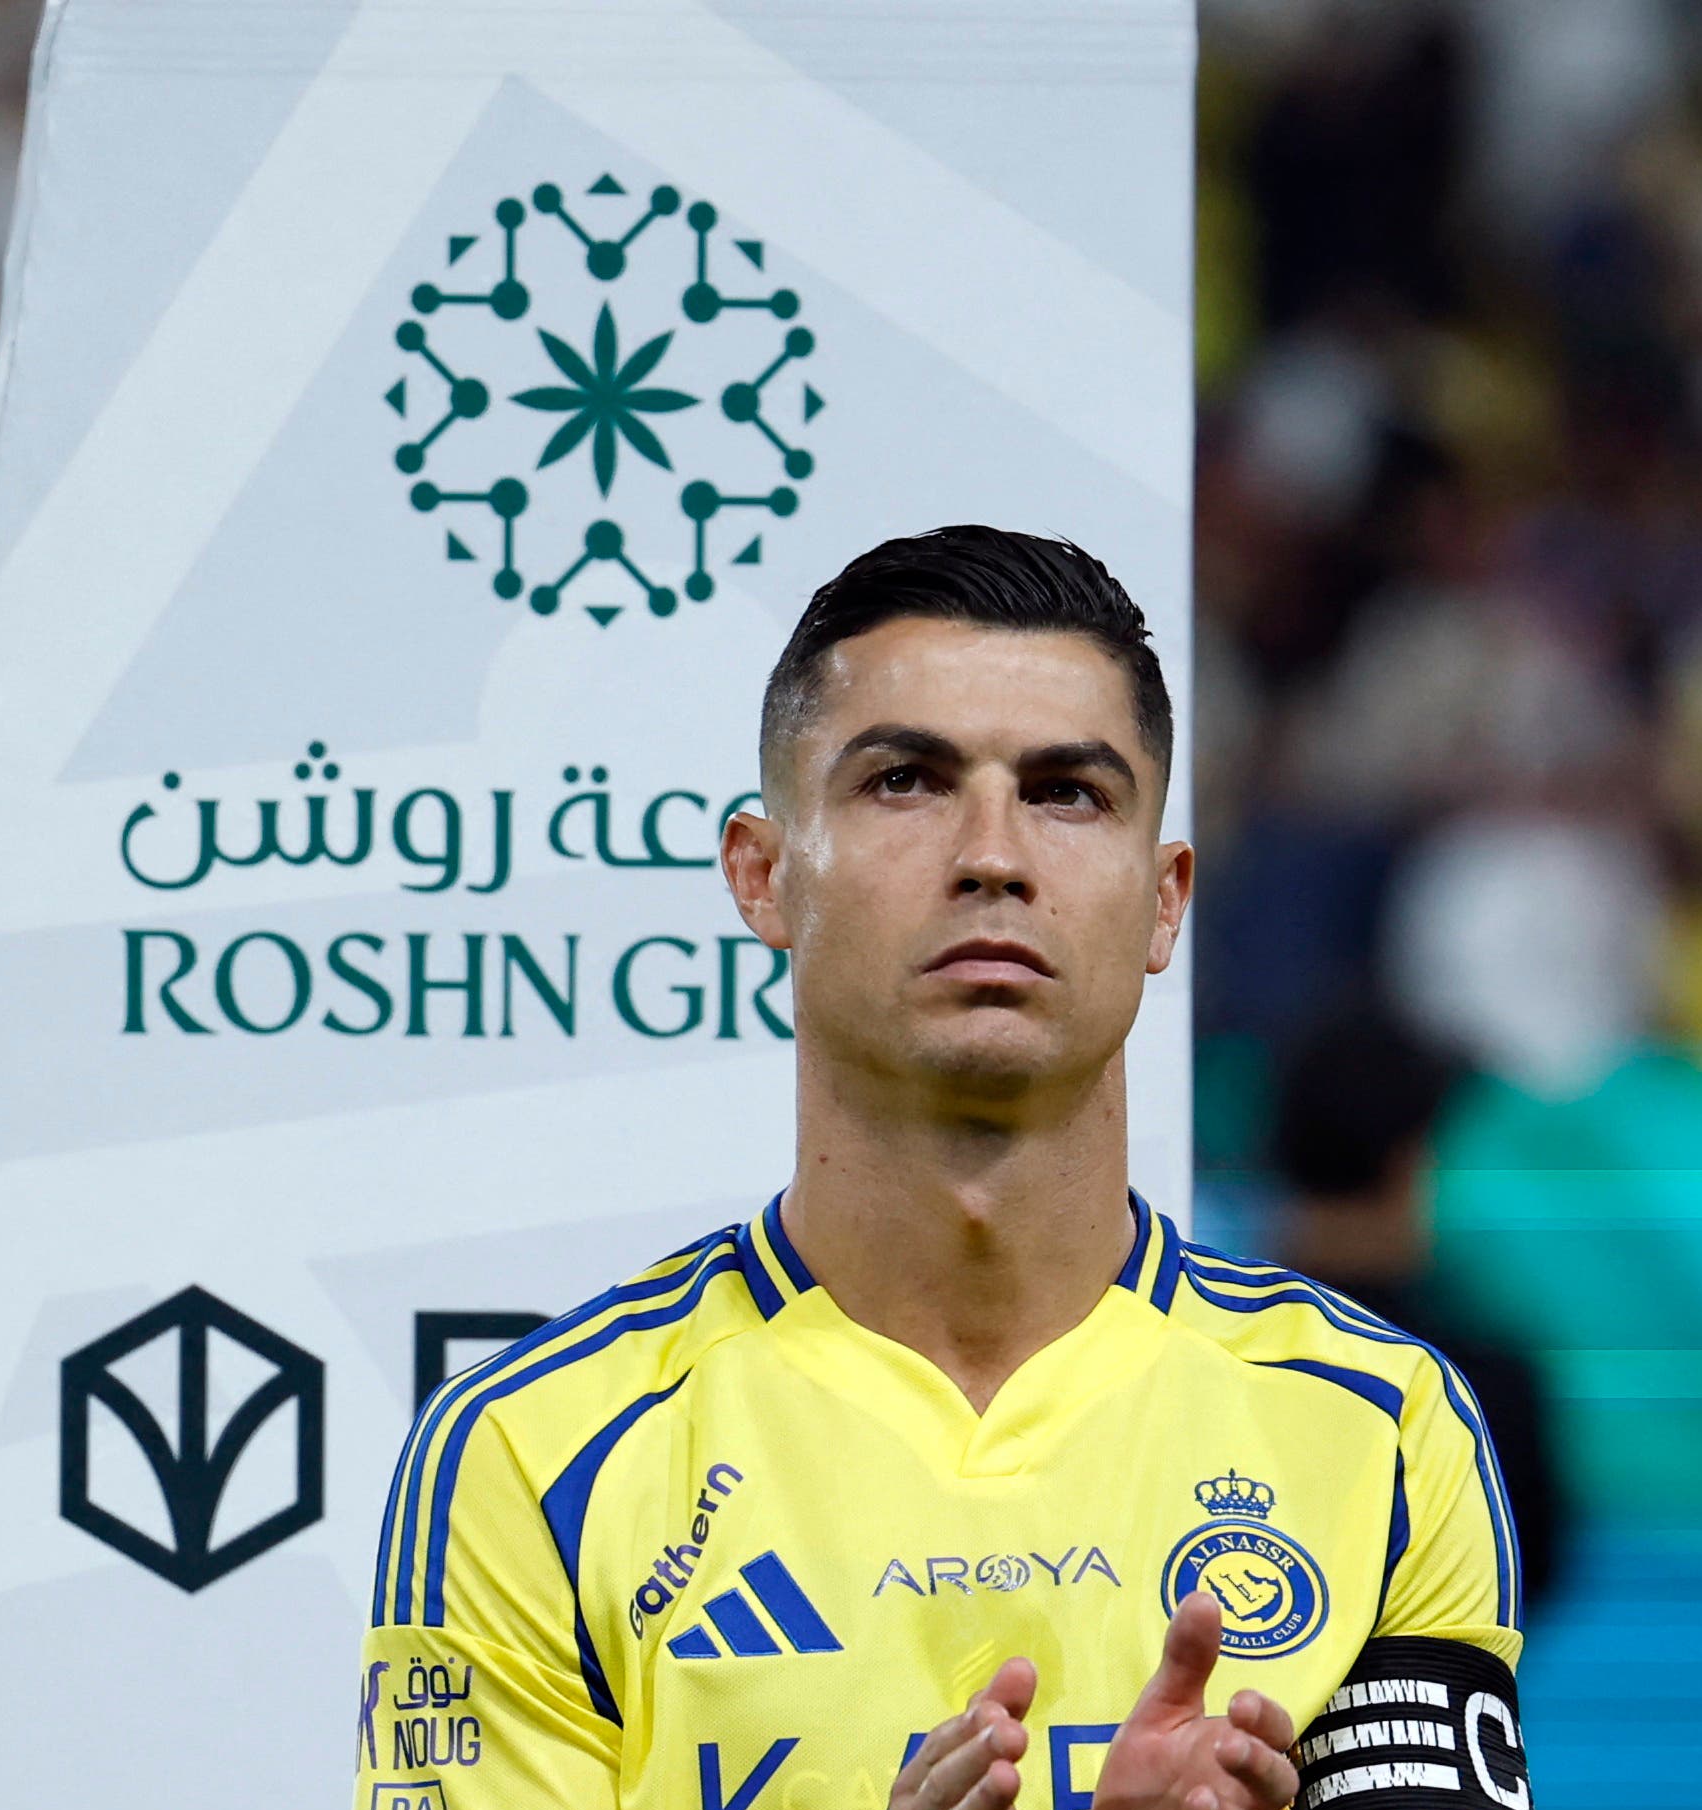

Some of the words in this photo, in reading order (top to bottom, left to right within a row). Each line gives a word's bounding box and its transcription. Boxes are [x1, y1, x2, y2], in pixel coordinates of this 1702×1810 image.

[120, 738, 516, 894] روشن
[120, 928, 583, 1040] ROSHN
[607, 934, 797, 1040] GR
[629, 1462, 745, 1641] Gathern
[871, 1545, 1122, 1598] AROYA
[1187, 1542, 1218, 1572] AL
[1217, 1534, 1296, 1574] NASSR
[1222, 1632, 1271, 1647] TBALL
[1272, 1612, 1303, 1641] CLUB
[393, 1656, 474, 1711] نوق
[392, 1715, 481, 1770] NOUG
